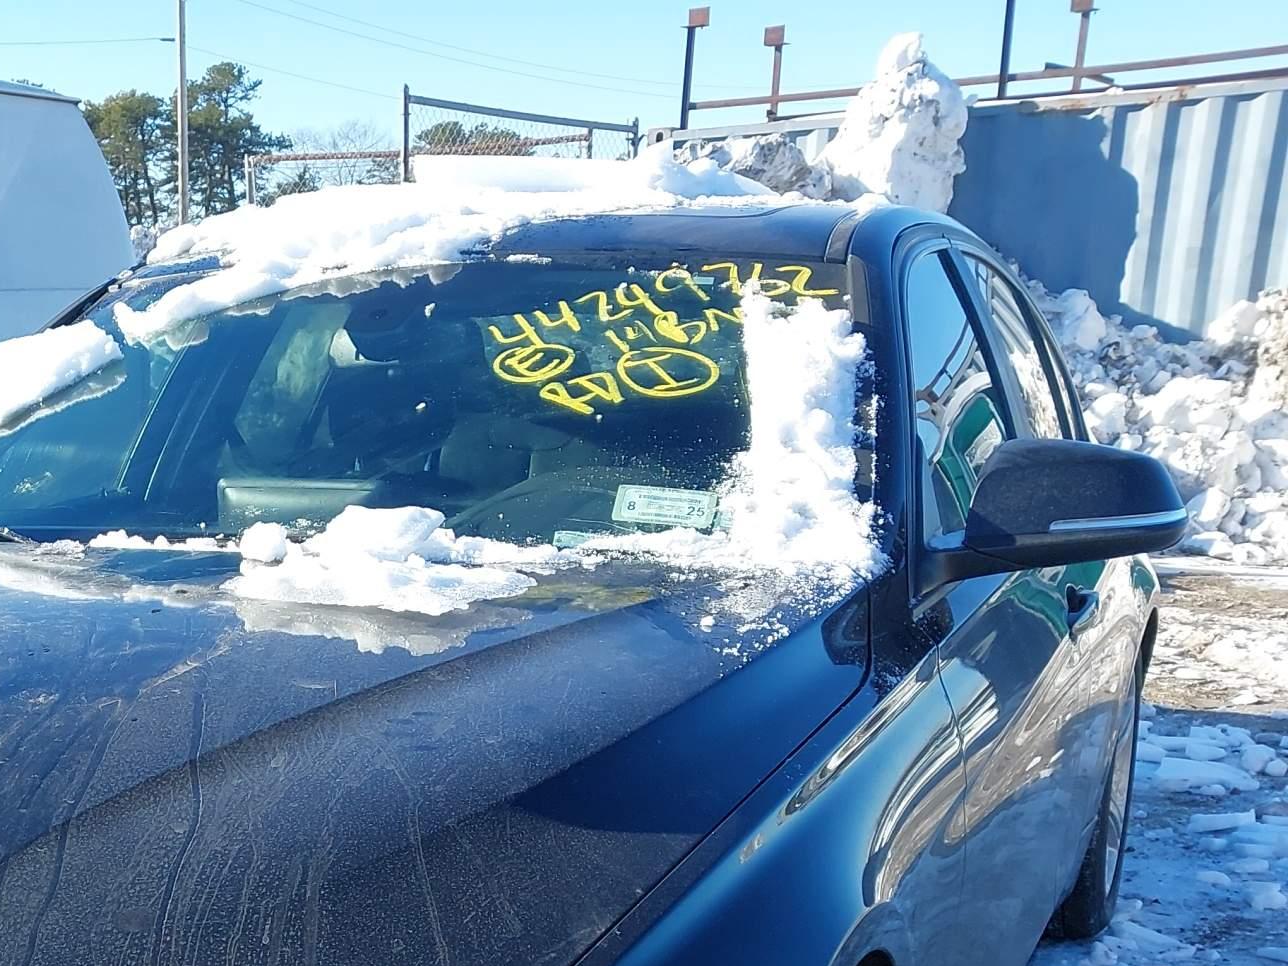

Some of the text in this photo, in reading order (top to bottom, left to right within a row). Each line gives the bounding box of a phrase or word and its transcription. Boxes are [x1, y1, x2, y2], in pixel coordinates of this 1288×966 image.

[487, 261, 840, 347] 44249762
[627, 501, 636, 511] 8
[686, 506, 705, 517] 25
